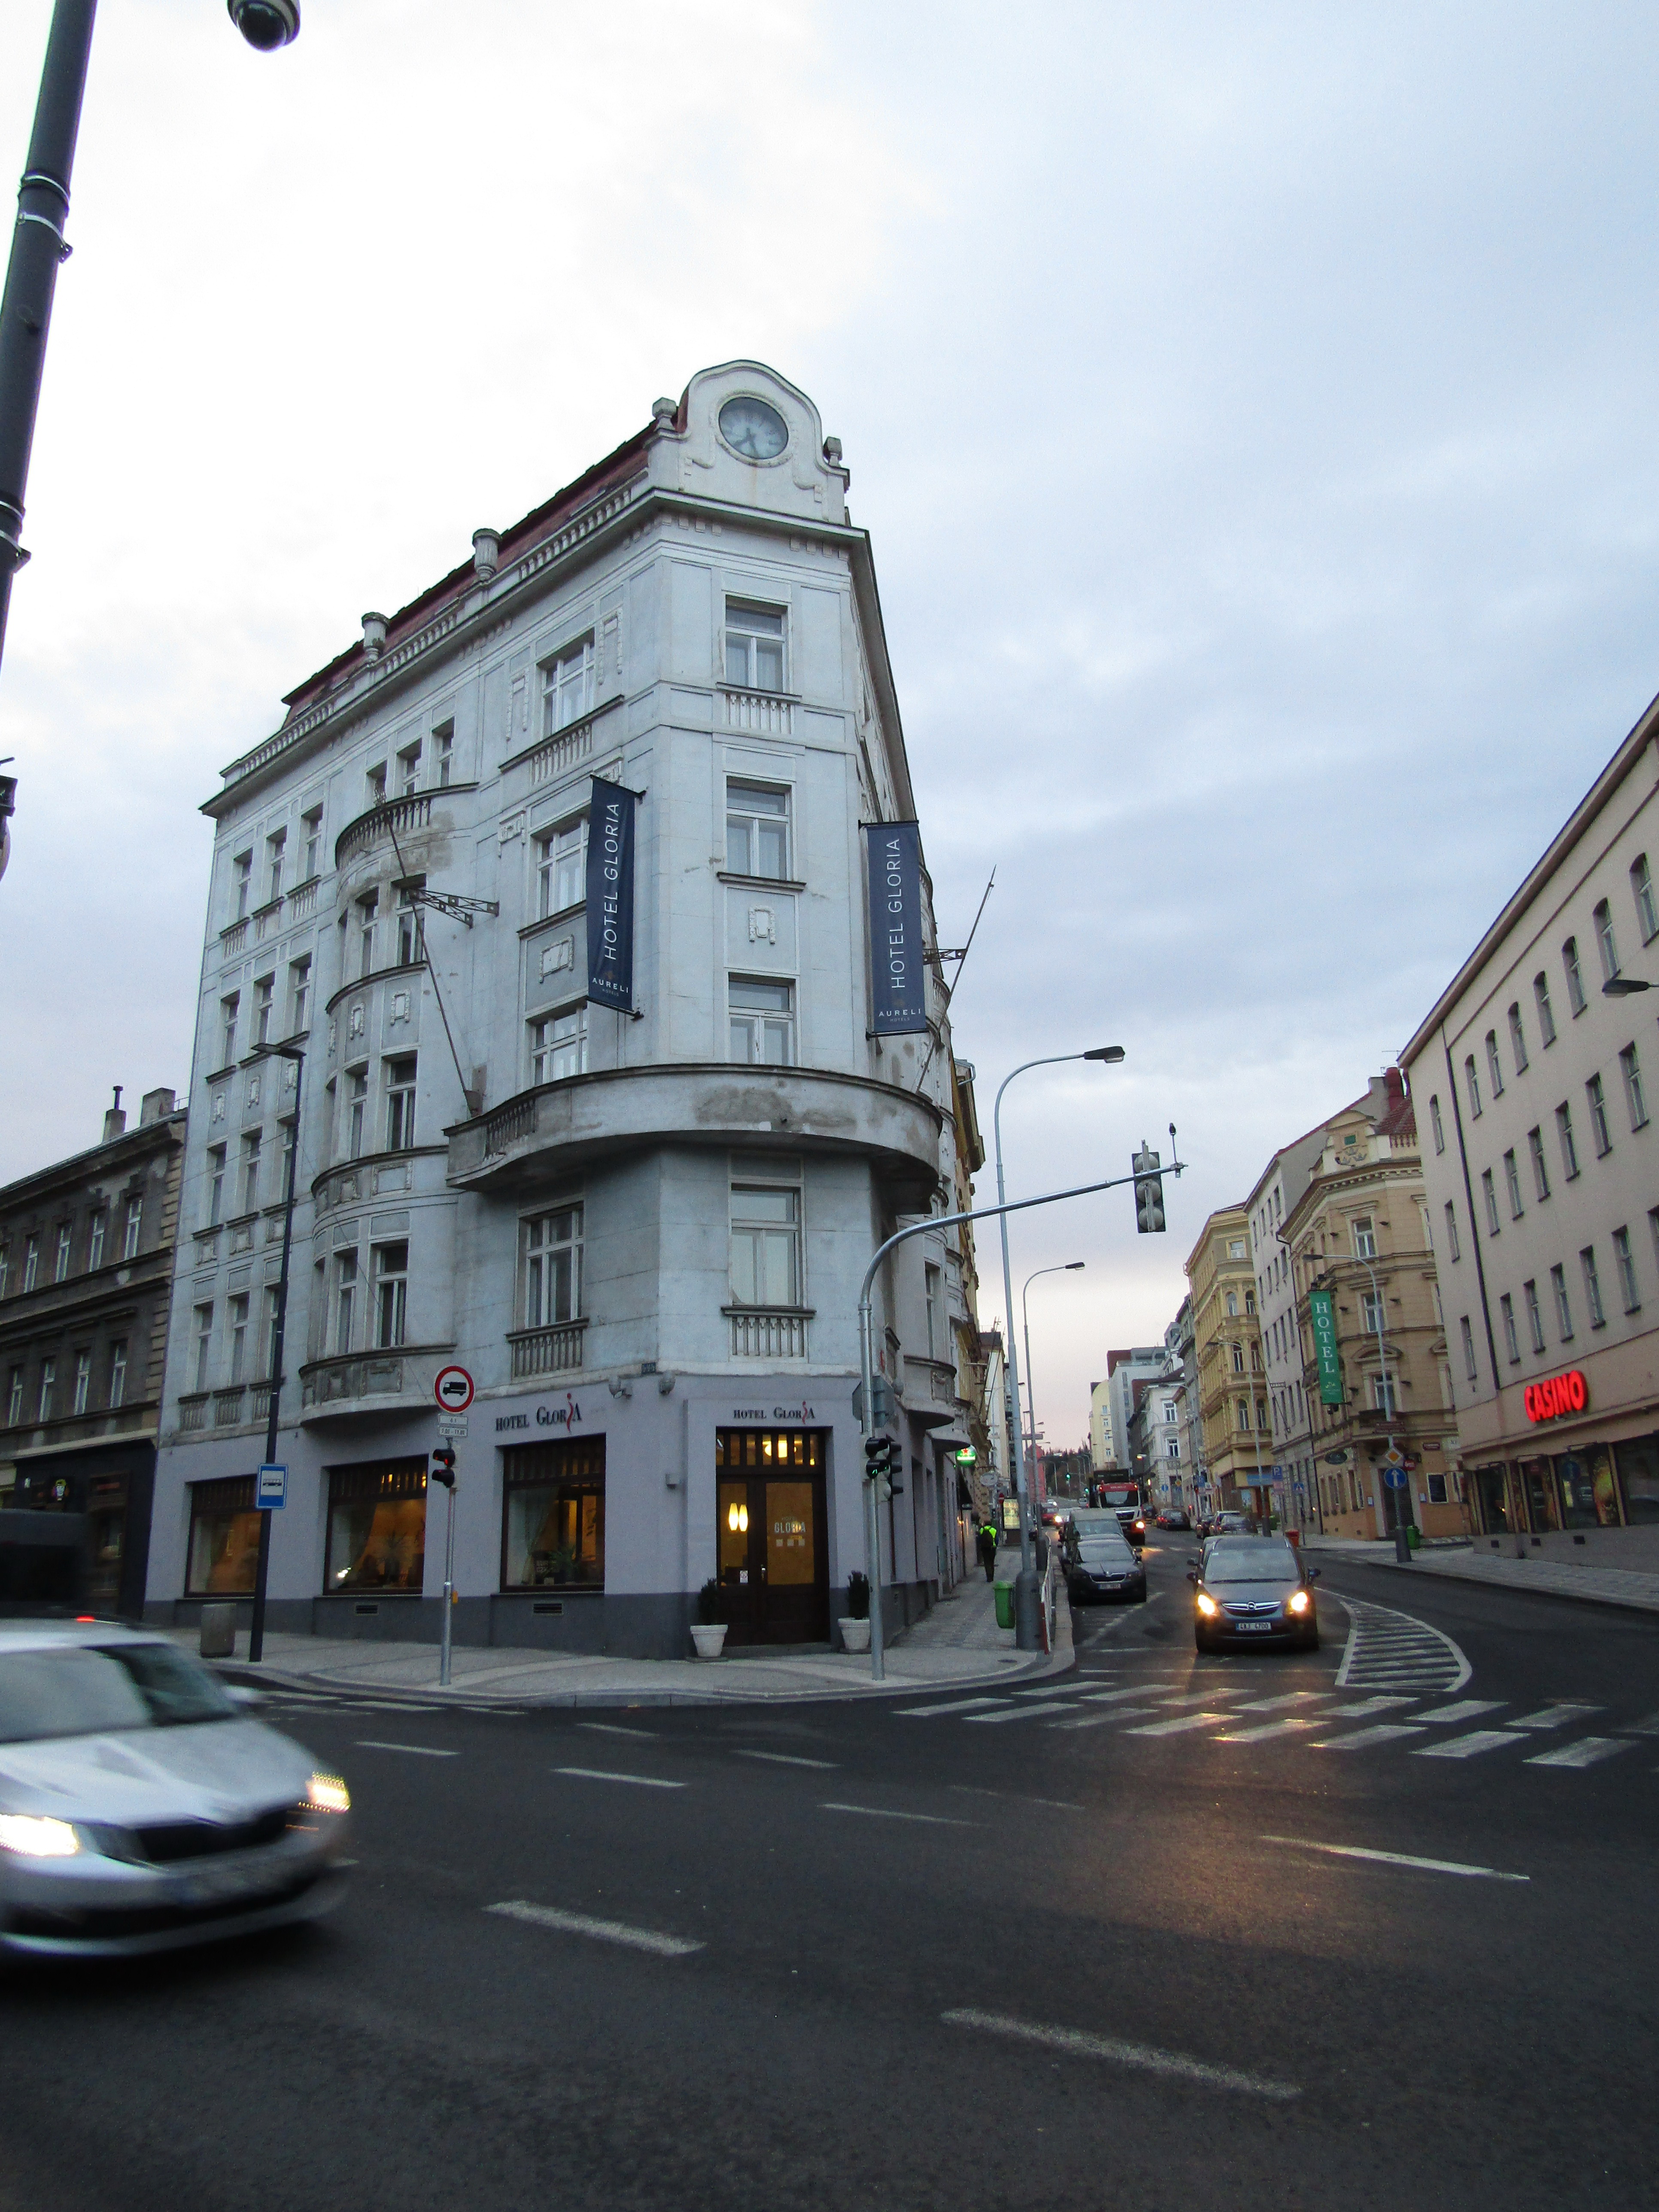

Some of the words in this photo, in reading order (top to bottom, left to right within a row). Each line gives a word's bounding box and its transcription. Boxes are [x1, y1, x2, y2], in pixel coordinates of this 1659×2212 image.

[604, 804, 619, 880] GLORIA
[886, 839, 902, 913] GLORIA
[604, 892, 618, 960] HOTEL
[889, 923, 905, 988] HOTEL
[592, 978, 629, 994] AURELI
[878, 1008, 921, 1017] AURELI
[1315, 1302, 1335, 1373] HOTEL
[496, 1414, 530, 1432] HOTEL
[537, 1393, 582, 1434] GLORIA
[733, 1410, 767, 1419] HOTEL
[773, 1401, 815, 1425] GLORIA
[1525, 1370, 1587, 1423] CASINO
